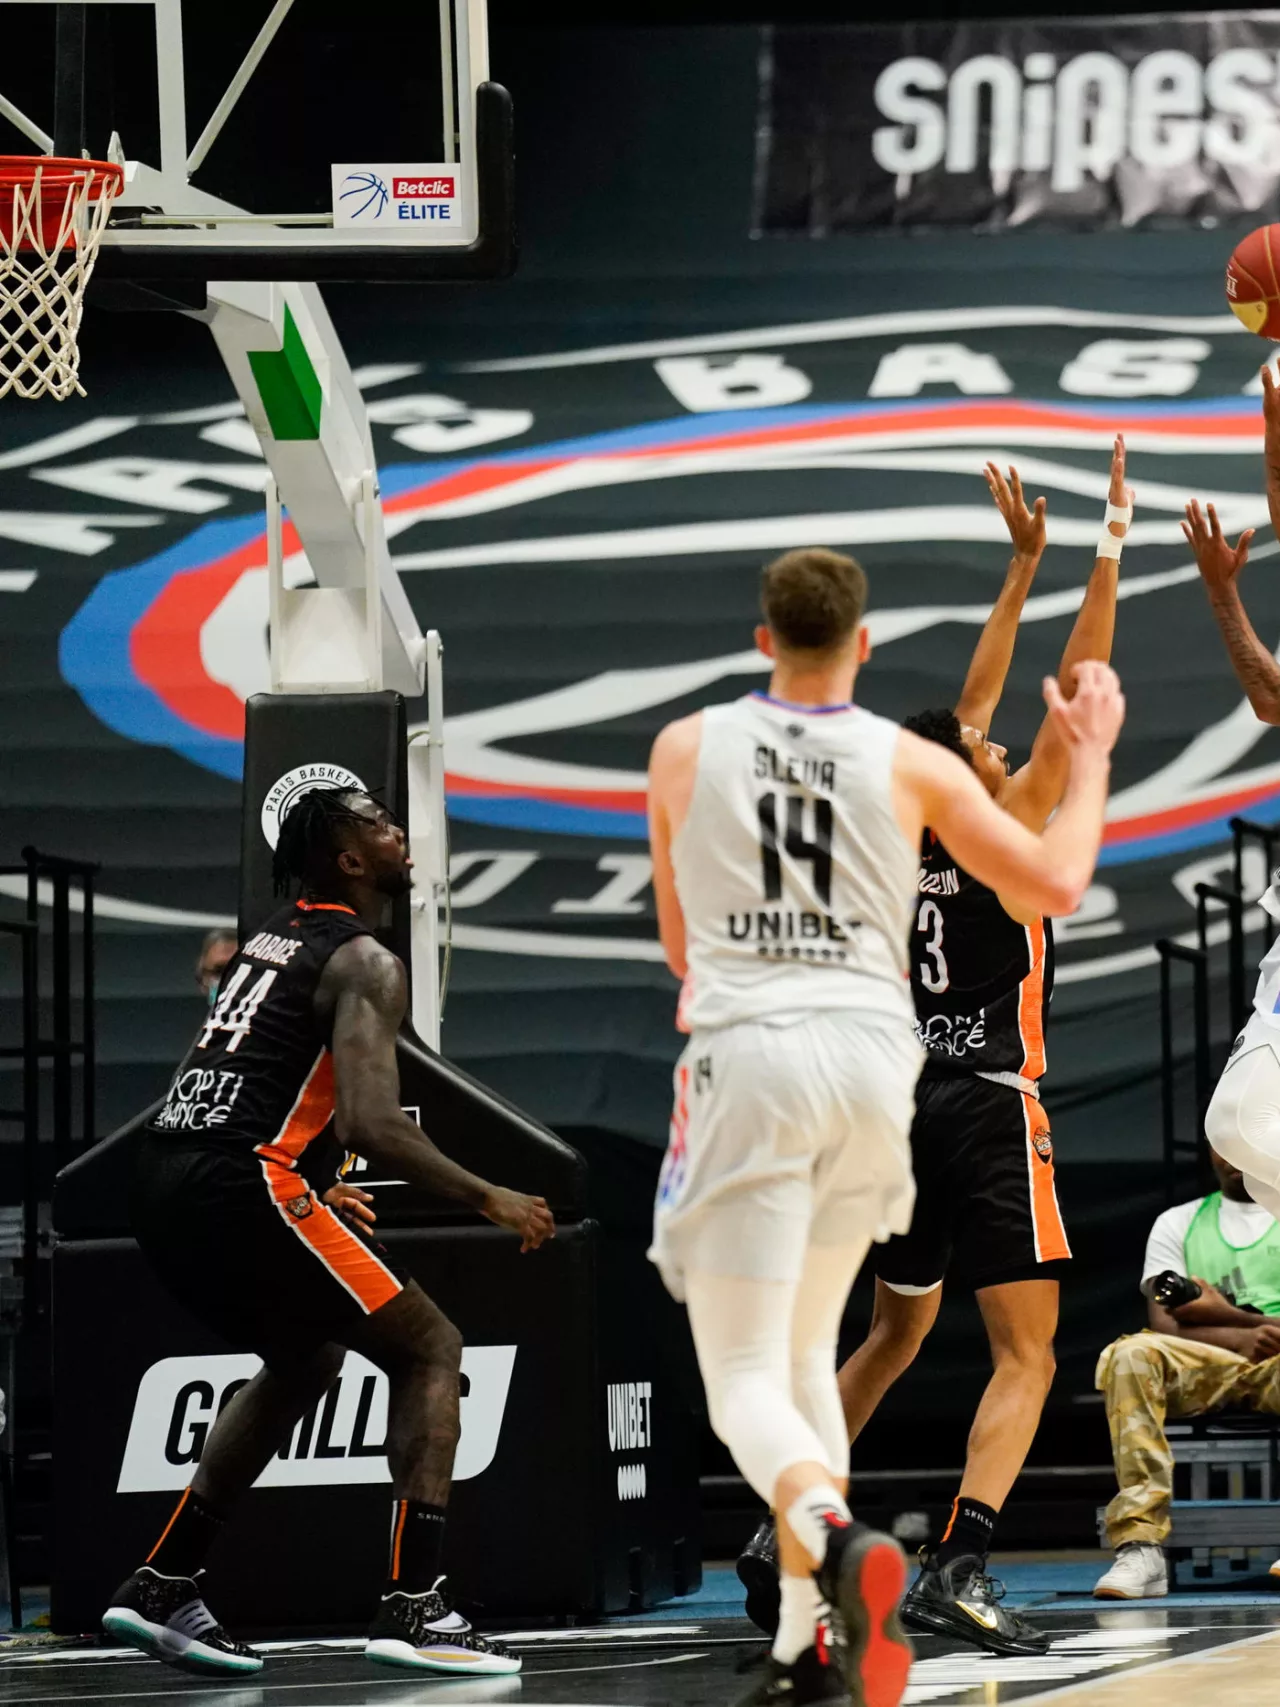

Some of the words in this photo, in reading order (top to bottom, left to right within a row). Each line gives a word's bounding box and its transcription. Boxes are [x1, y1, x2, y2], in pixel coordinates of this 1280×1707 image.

[397, 181, 450, 195] Betclic
[398, 201, 451, 220] ÉLITE
[265, 776, 295, 812] PARIS
[299, 767, 359, 790] BASKETB
[758, 792, 834, 907] 14
[917, 900, 950, 994] 3
[197, 962, 278, 1053] 44
[607, 1381, 652, 1452] UNIBET
